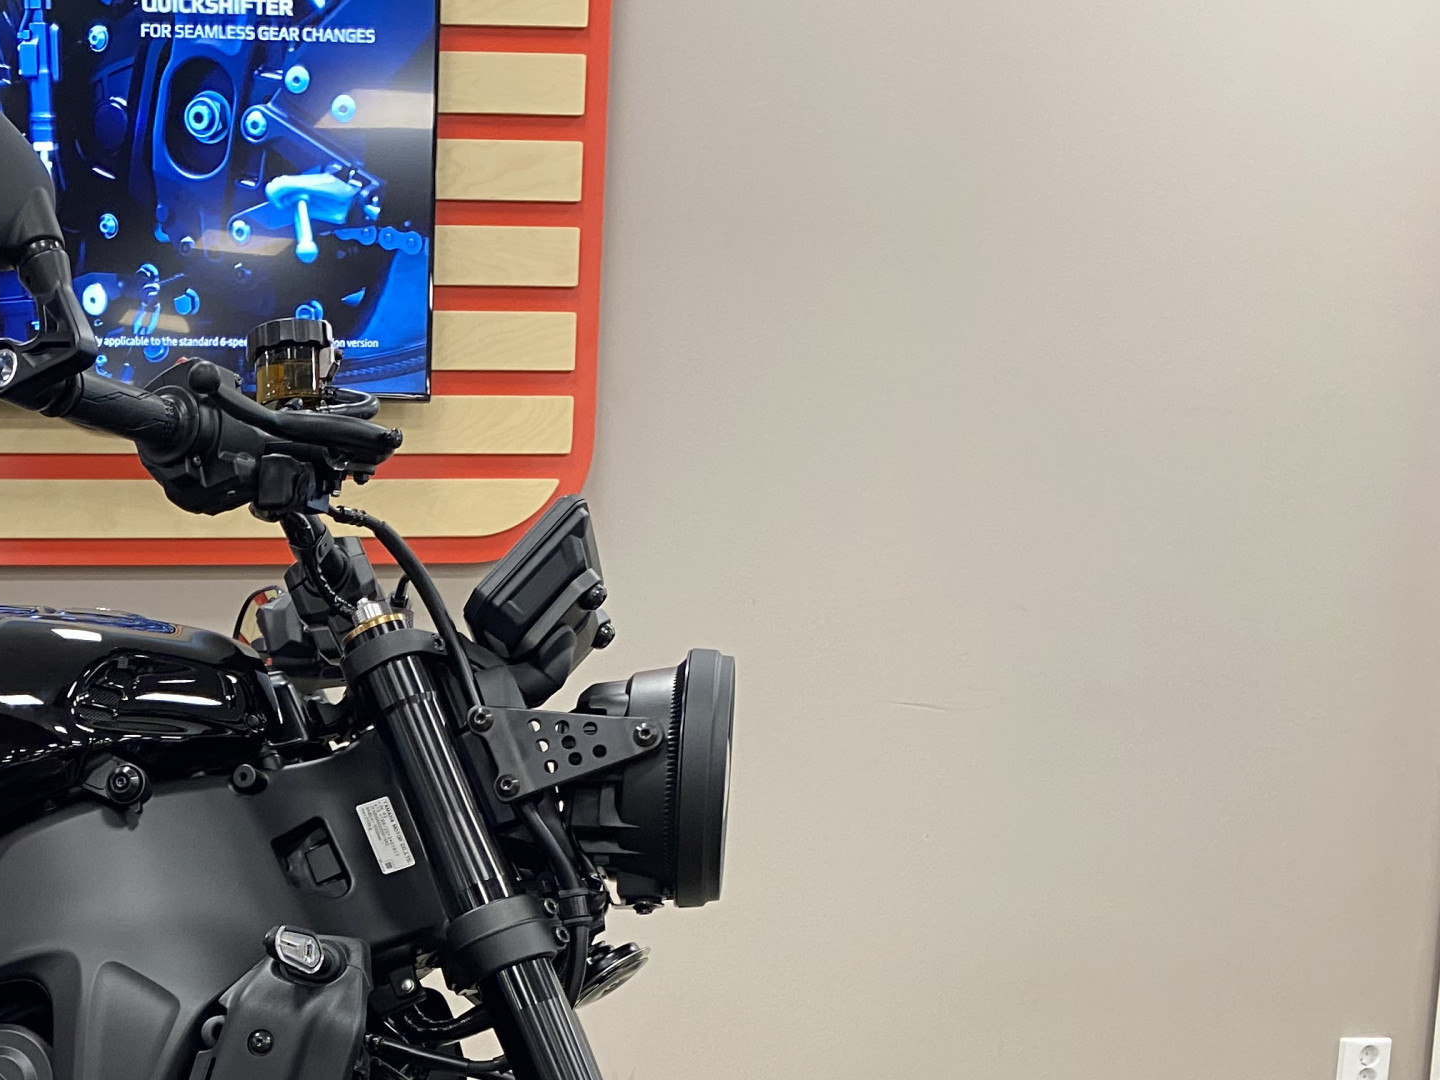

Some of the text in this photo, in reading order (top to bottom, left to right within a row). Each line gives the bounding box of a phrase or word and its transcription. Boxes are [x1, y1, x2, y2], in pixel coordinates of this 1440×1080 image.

[141, 0, 294, 16] QUICKSHIFTER
[140, 23, 376, 43] FOR SEAMLESS GEAR CHANGES
[103, 336, 150, 348] applicable
[150, 336, 161, 346] to
[162, 336, 178, 346] the
[179, 336, 219, 347] standard
[346, 338, 379, 348] version
